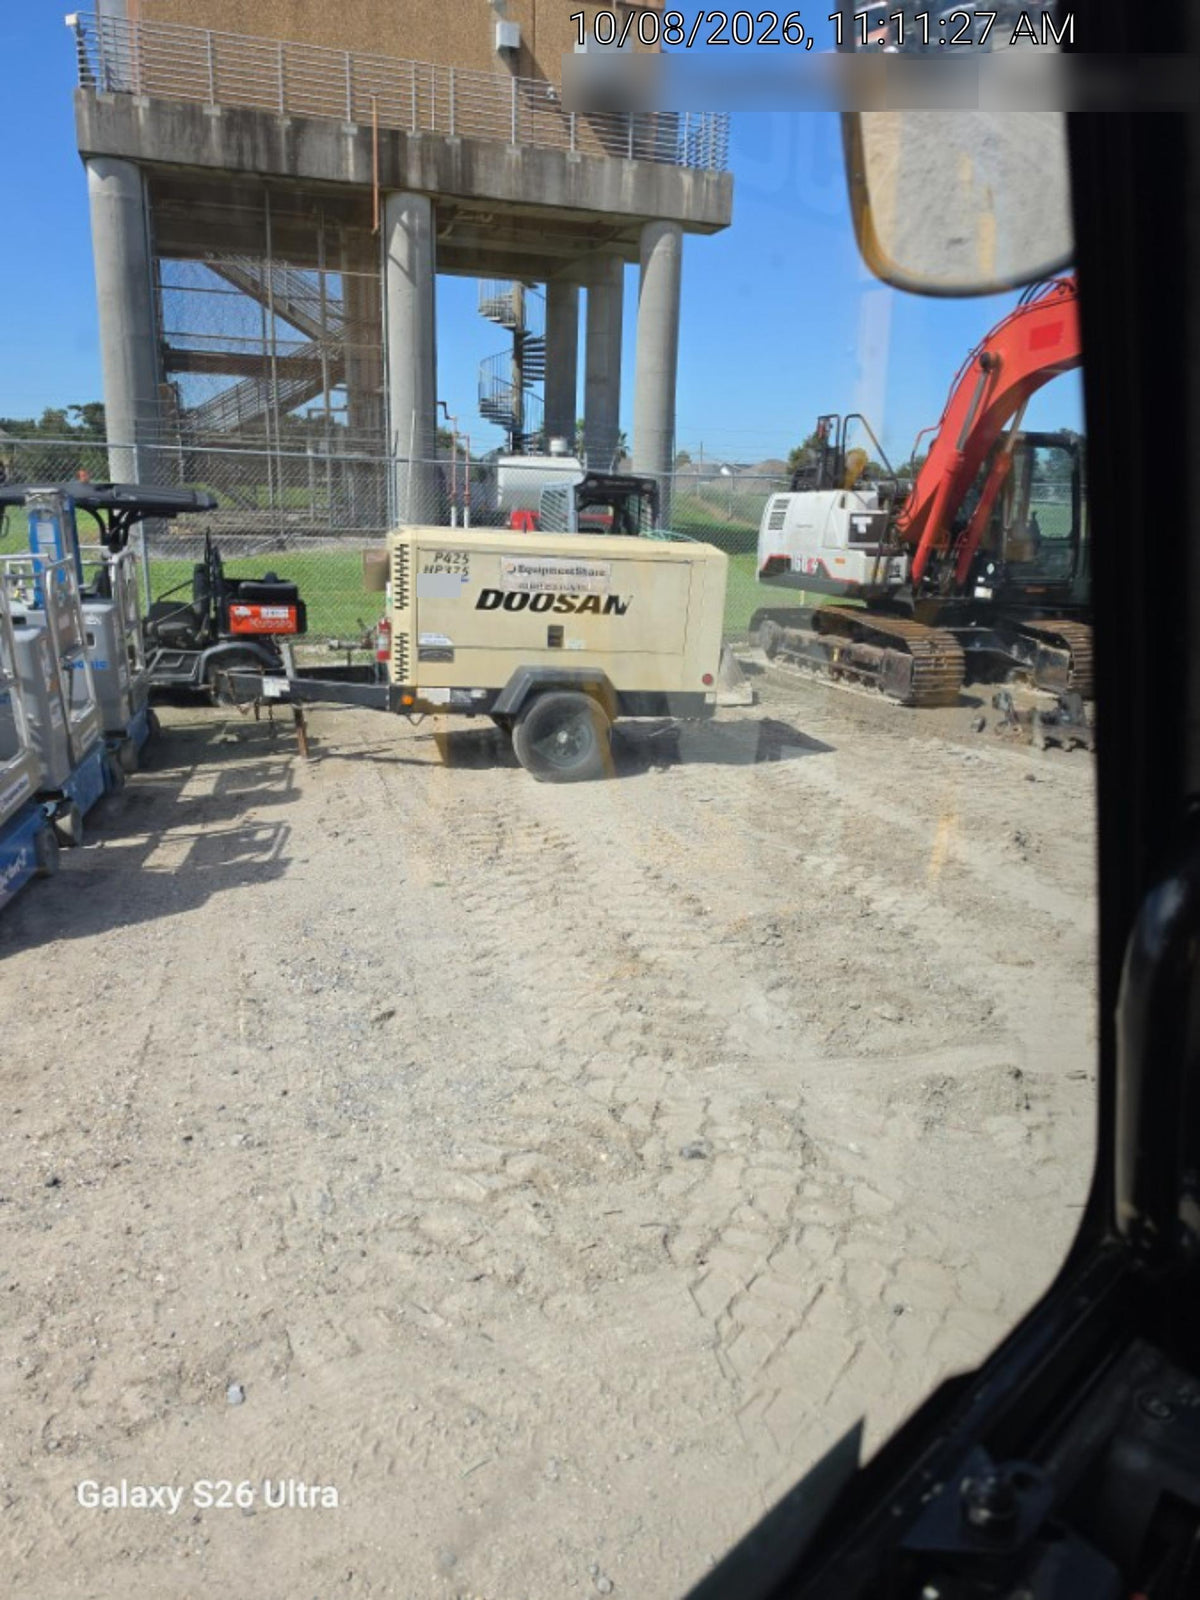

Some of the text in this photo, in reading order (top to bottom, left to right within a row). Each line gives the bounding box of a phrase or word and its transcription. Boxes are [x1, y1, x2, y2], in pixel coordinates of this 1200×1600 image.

[434, 552, 469, 564] P425
[518, 564, 606, 576] EquipmentShare
[475, 588, 632, 615] DOOSAN
